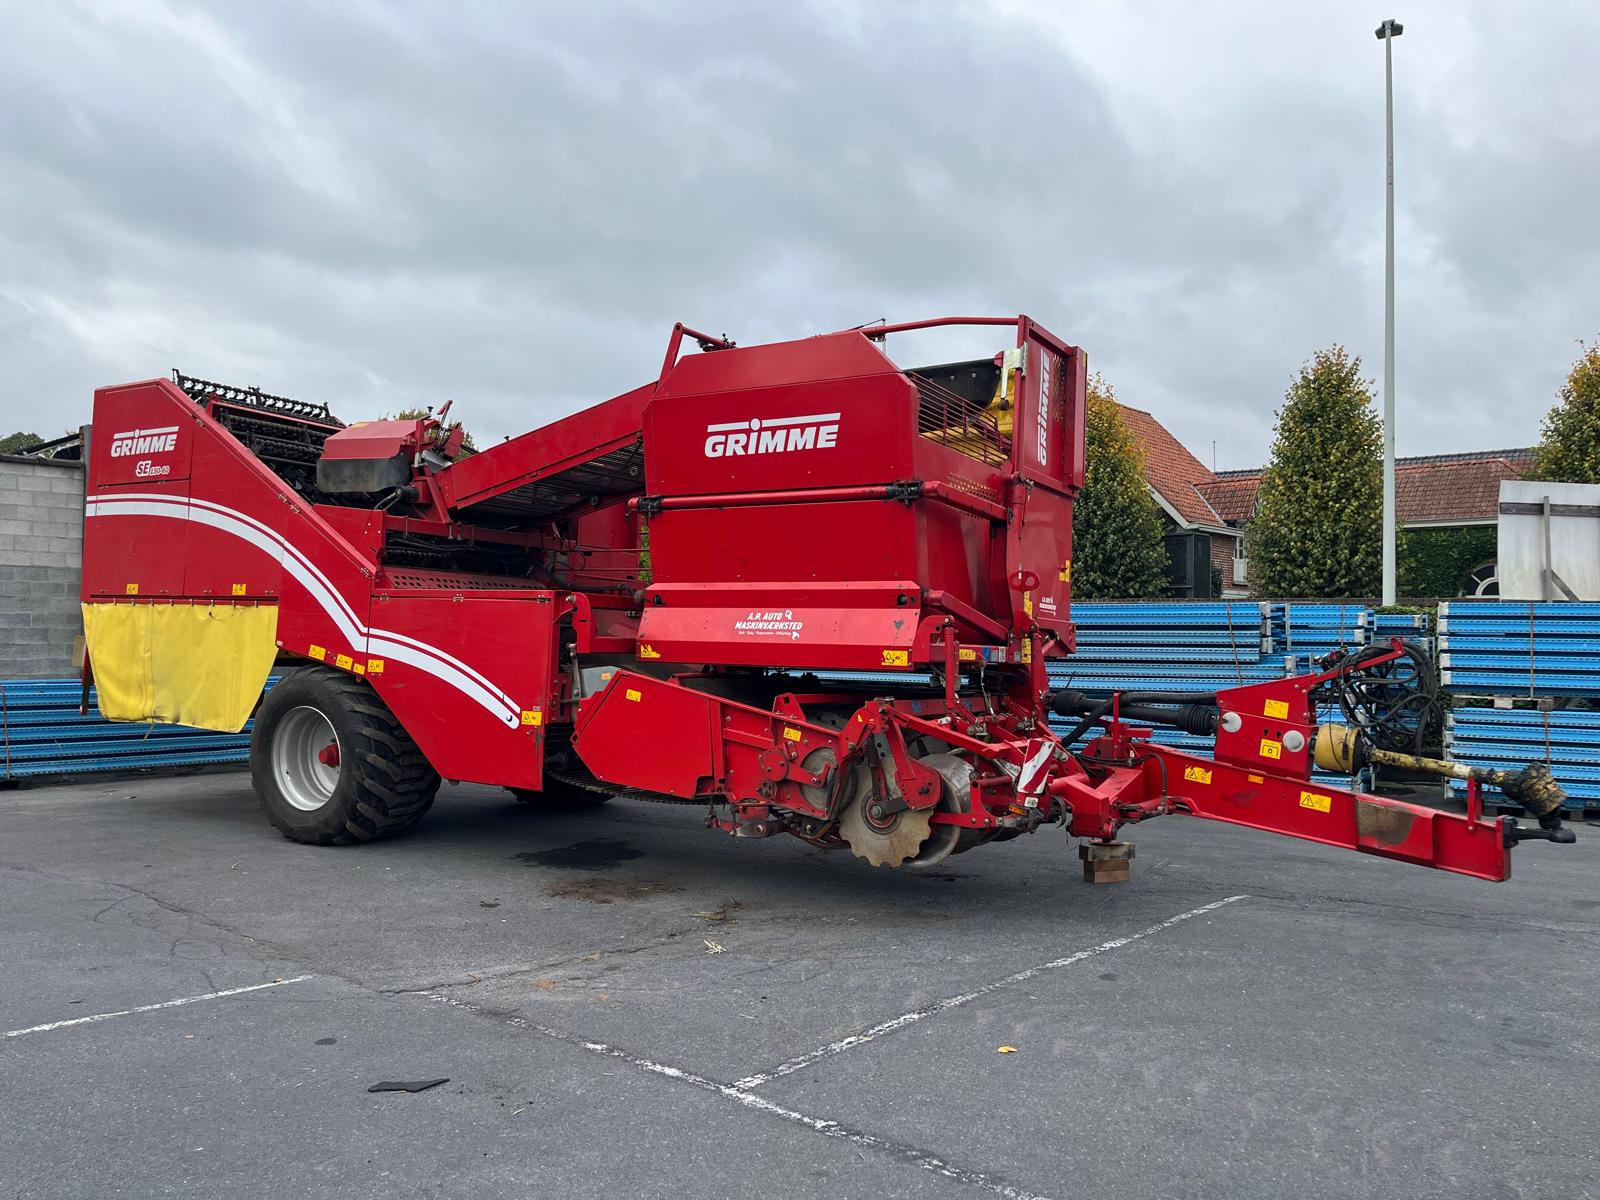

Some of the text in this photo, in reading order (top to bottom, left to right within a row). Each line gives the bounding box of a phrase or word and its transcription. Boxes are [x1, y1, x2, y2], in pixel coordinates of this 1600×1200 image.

[1038, 350, 1050, 466] GRIMME
[110, 428, 178, 457] GRIMME
[704, 416, 840, 458] GRIMME
[734, 621, 804, 630] MASKINVÆRKSTED
[762, 612, 783, 621] AUTO
